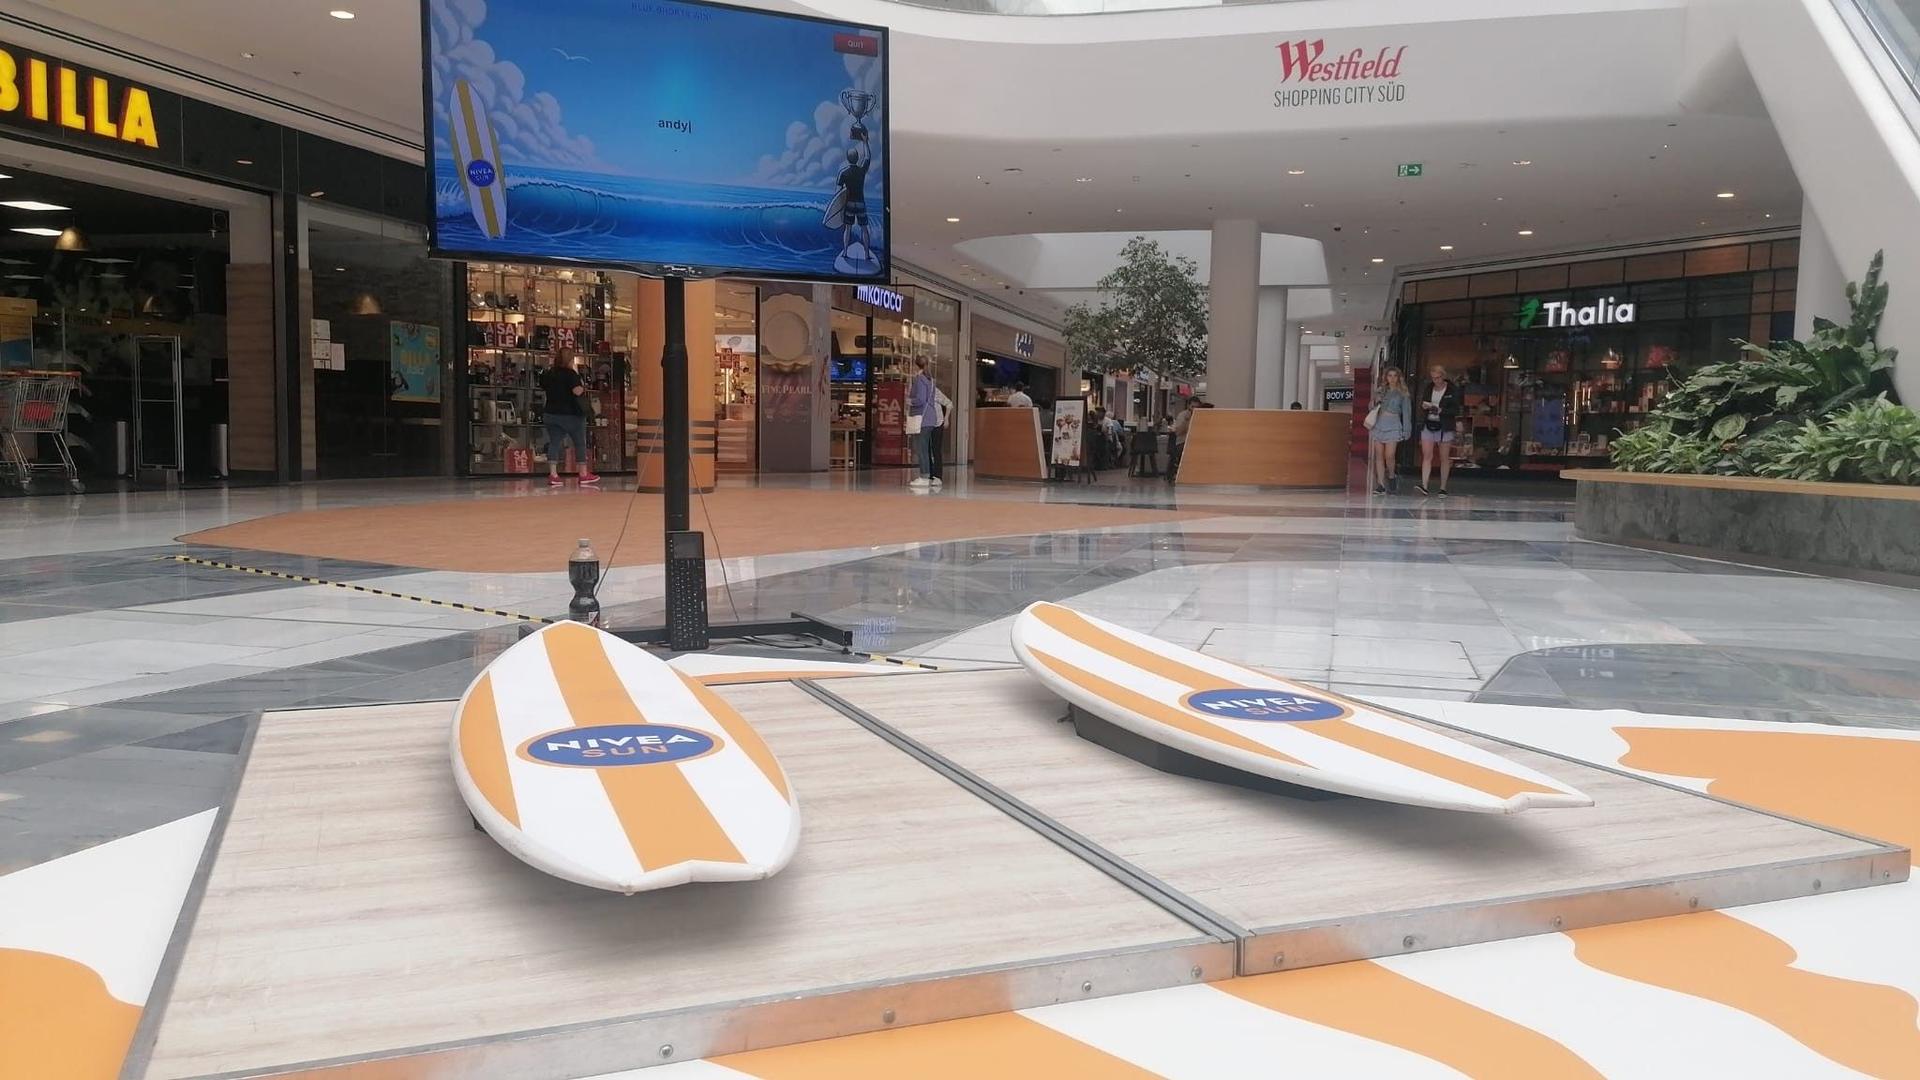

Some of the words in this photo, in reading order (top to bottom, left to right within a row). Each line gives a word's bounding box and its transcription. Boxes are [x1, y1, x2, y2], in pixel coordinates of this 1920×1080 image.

[1275, 38, 1409, 83] Westfield
[1274, 87, 1341, 108] SHOPPING
[1344, 86, 1375, 104] CITY
[1378, 81, 1405, 103] SÜD
[1543, 296, 1635, 328] Thalia
[1326, 391, 1344, 400] BODY
[1345, 391, 1354, 400] SH
[879, 399, 901, 412] SA
[880, 411, 900, 425] LE
[513, 449, 529, 460] SA
[1201, 696, 1321, 710] NIVEA
[1245, 706, 1315, 716] SUN
[547, 733, 700, 752] NIVEA
[582, 744, 669, 758] SUN
